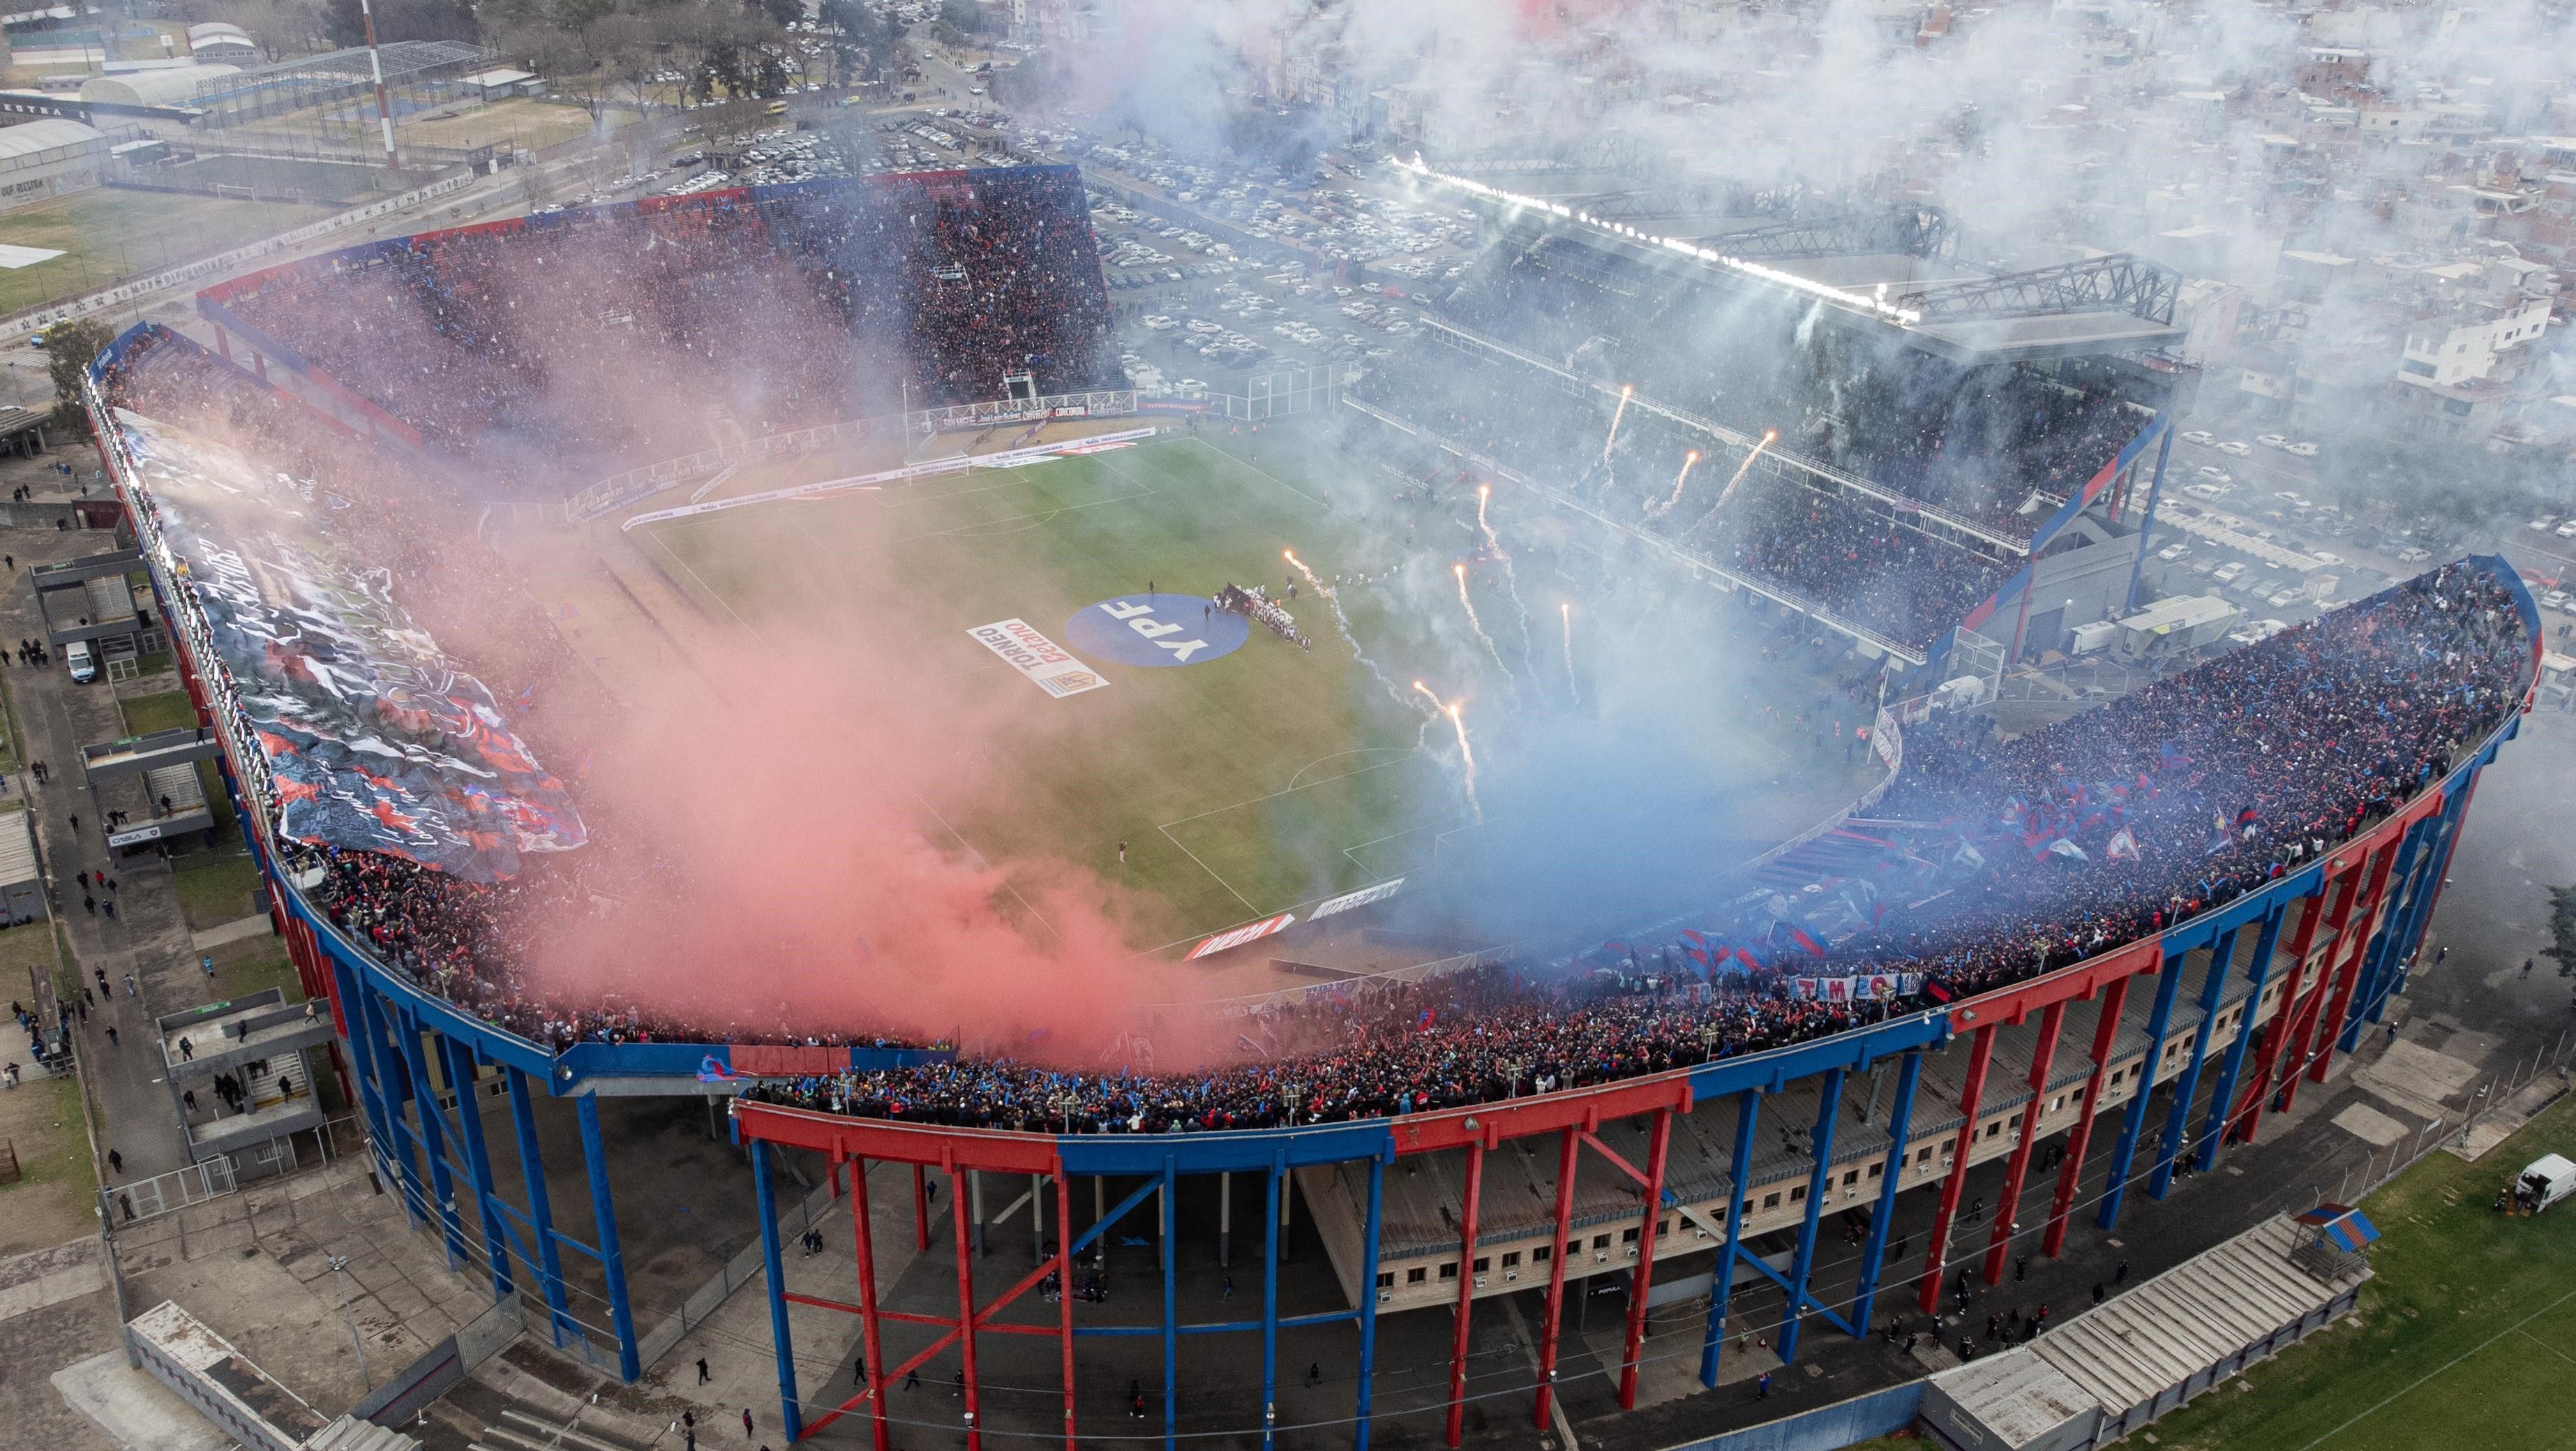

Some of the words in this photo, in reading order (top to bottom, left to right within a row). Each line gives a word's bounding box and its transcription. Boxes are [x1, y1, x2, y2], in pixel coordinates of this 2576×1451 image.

[976, 627, 1042, 672] TORNEO
[1005, 622, 1072, 664] Betano
[1099, 600, 1209, 663] YPF
